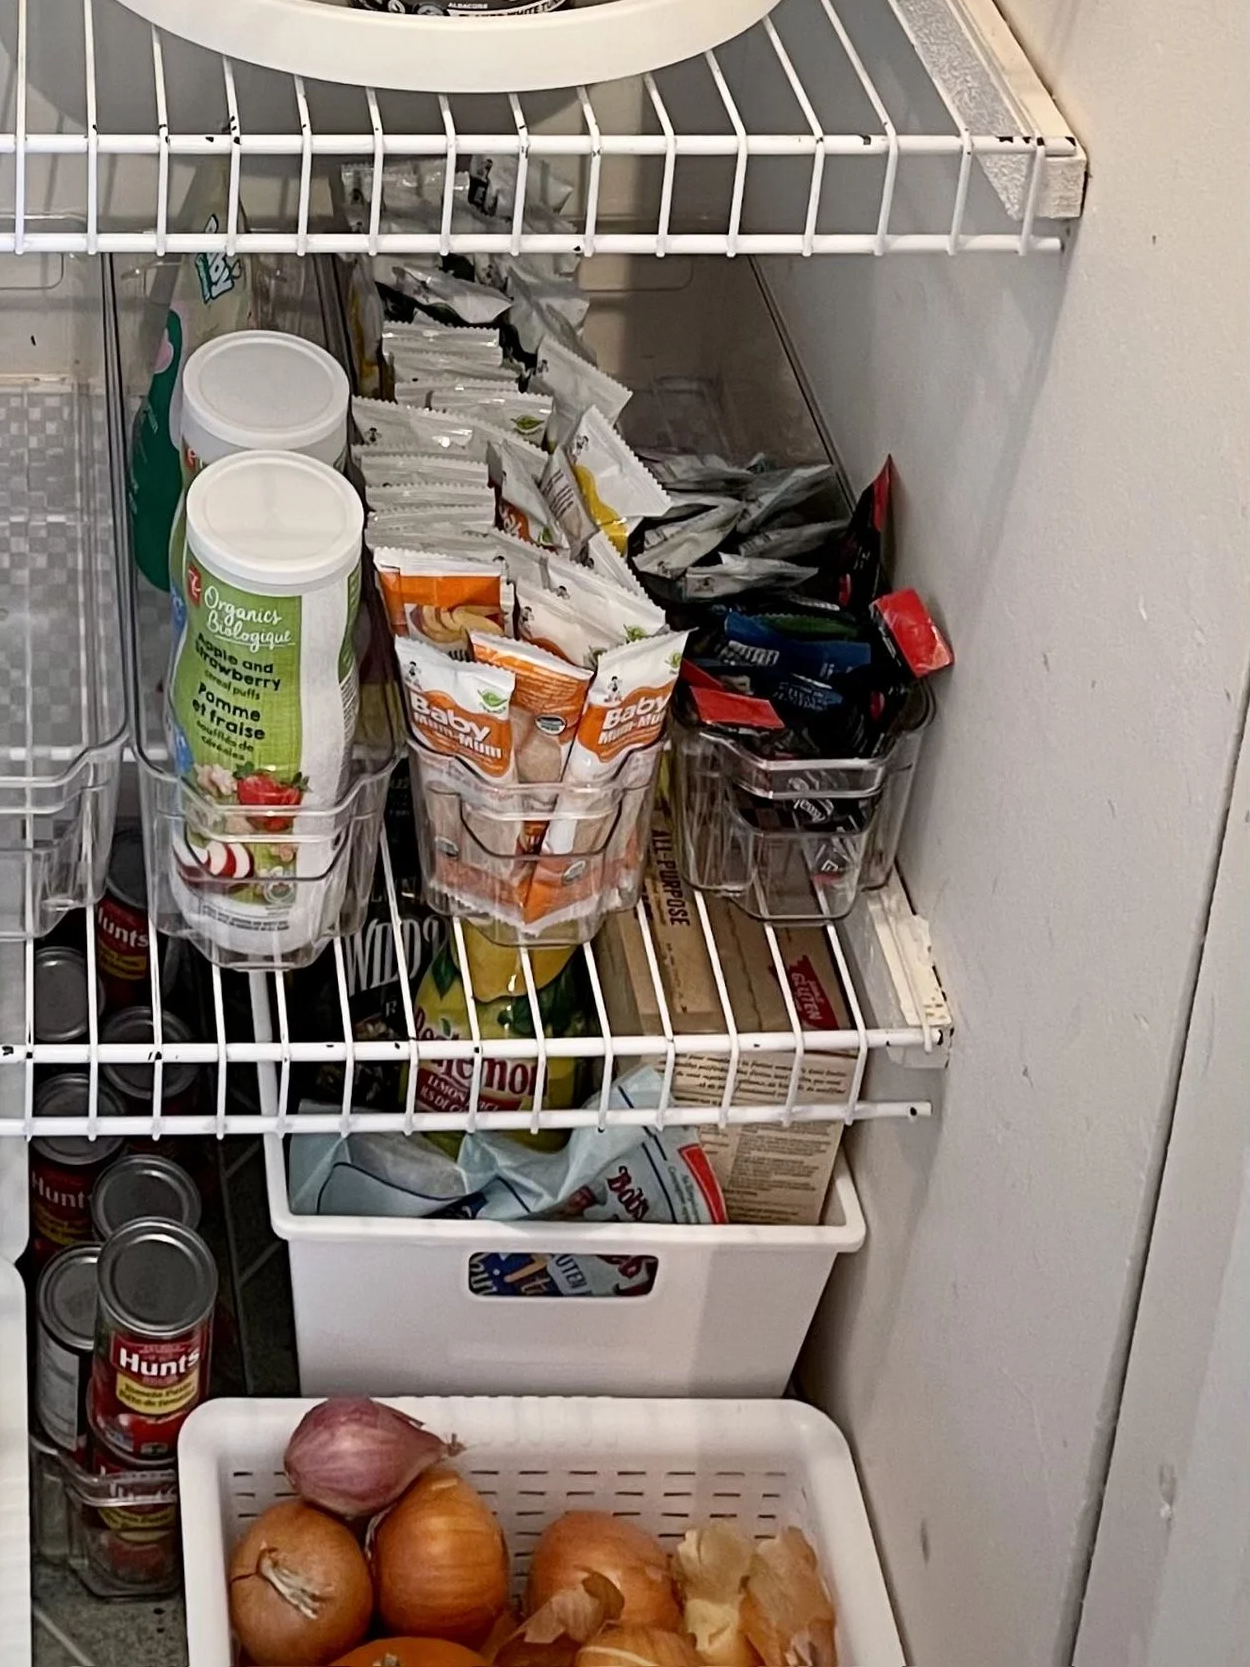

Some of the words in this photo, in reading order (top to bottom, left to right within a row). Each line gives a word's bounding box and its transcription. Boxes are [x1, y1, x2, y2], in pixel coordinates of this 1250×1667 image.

[204, 586, 283, 626] Organics
[207, 610, 292, 654] Biologique
[198, 633, 239, 666] Apple
[242, 659, 274, 675] and
[197, 681, 261, 723] Pomme
[232, 684, 261, 701] puffs
[603, 693, 668, 731] Baby
[192, 698, 207, 718] et
[209, 708, 266, 741] fraise
[411, 689, 491, 742] Baby
[238, 739, 255, 753] de
